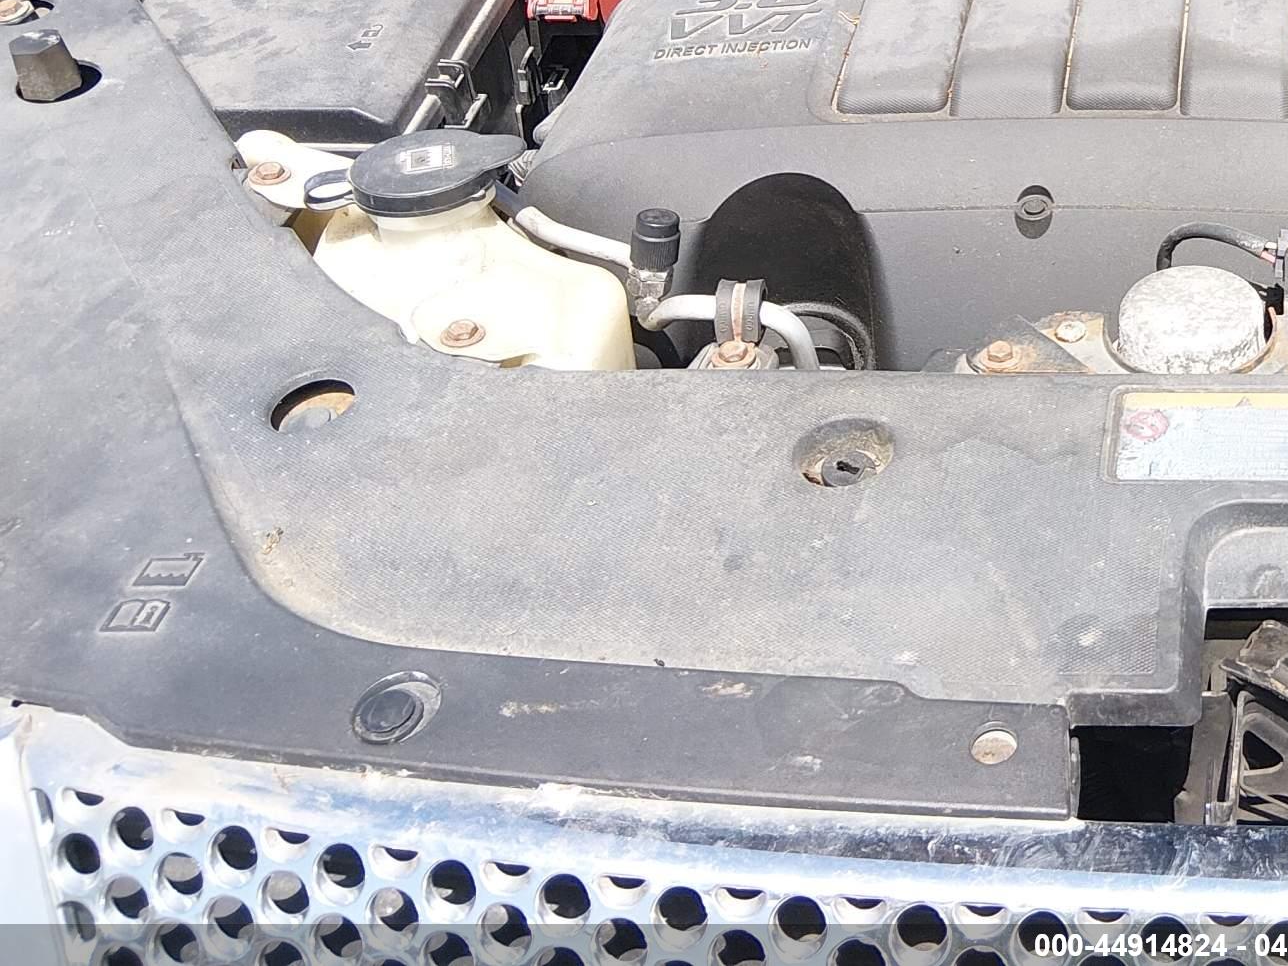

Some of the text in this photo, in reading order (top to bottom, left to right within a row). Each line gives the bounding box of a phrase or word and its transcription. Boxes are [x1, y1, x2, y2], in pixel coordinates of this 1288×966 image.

[670, 8, 823, 40] VVT
[653, 37, 812, 60] DIRECT INJECTION
